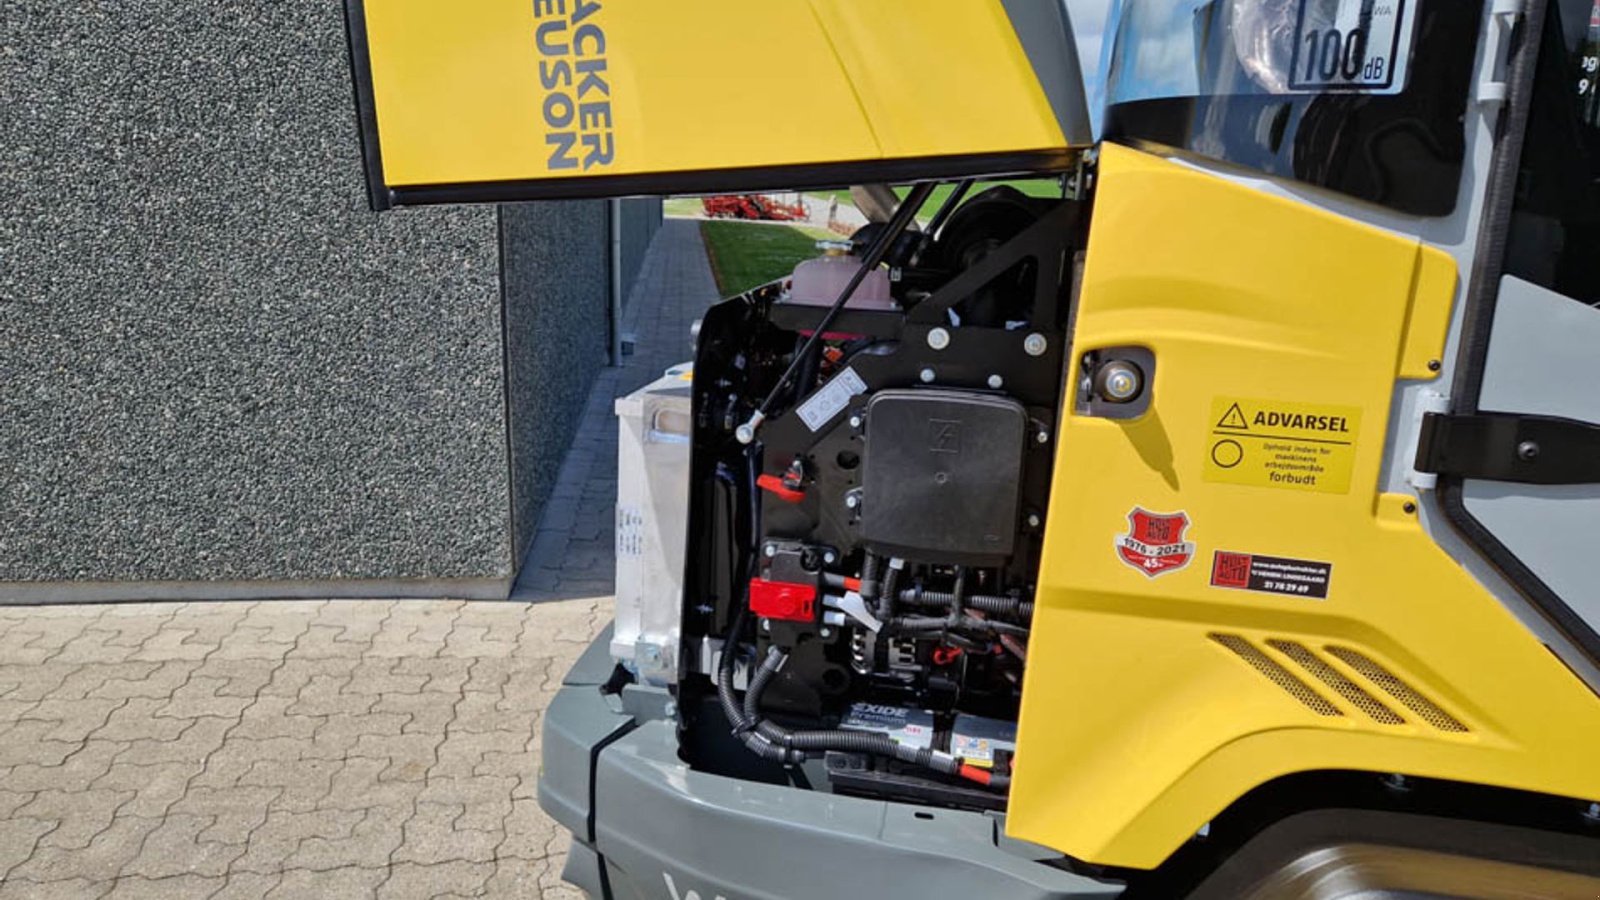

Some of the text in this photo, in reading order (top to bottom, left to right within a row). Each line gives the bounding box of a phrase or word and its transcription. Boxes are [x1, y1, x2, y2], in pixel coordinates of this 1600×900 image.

[1305, 28, 1365, 81] 100
[1364, 56, 1384, 79] dB
[1253, 411, 1349, 433] ADVARSEL
[1269, 471, 1316, 485] forbudt
[1124, 537, 1147, 554] 1976
[1157, 544, 1186, 556] 2021
[850, 711, 906, 725] Premium
[851, 702, 910, 718] EXIDE
